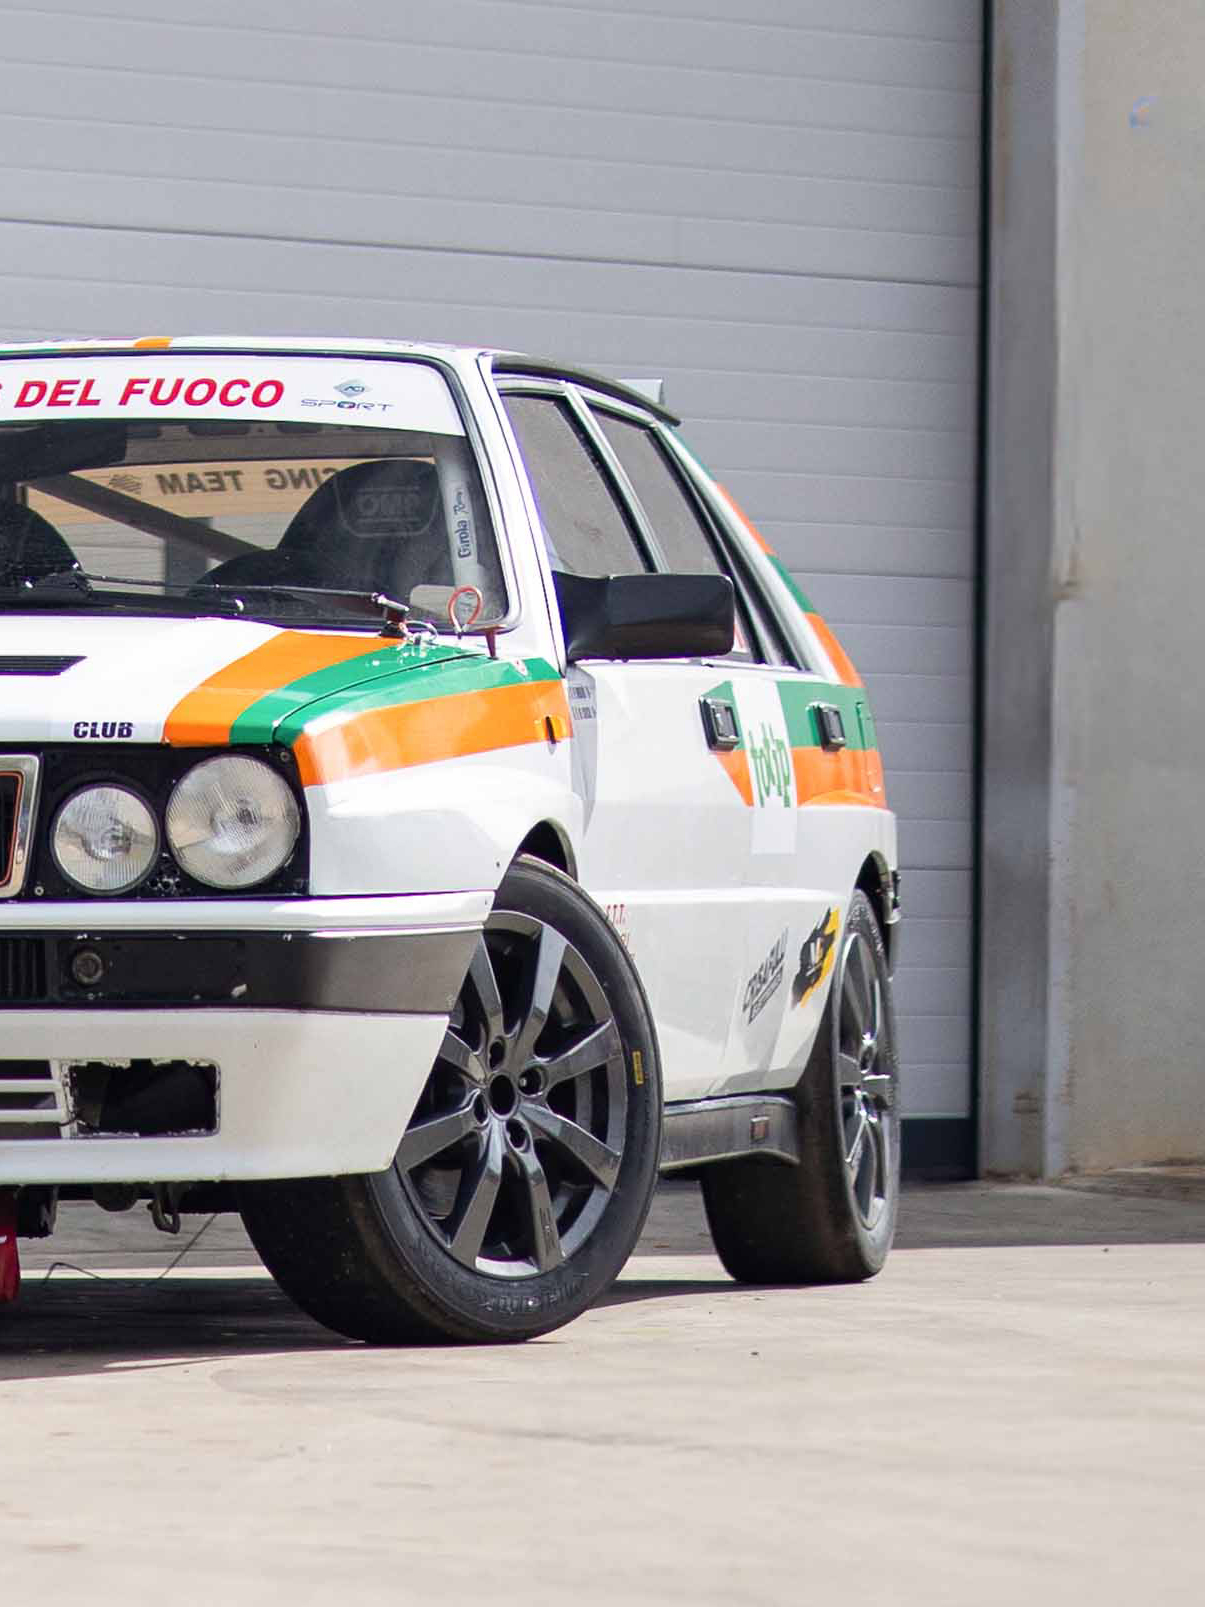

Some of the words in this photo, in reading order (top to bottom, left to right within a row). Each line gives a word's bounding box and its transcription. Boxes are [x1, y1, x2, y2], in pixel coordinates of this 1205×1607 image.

[13, 379, 102, 409] DEL
[118, 378, 285, 409] FUOCO
[300, 398, 395, 411] SPORT
[73, 721, 135, 739] CLUB
